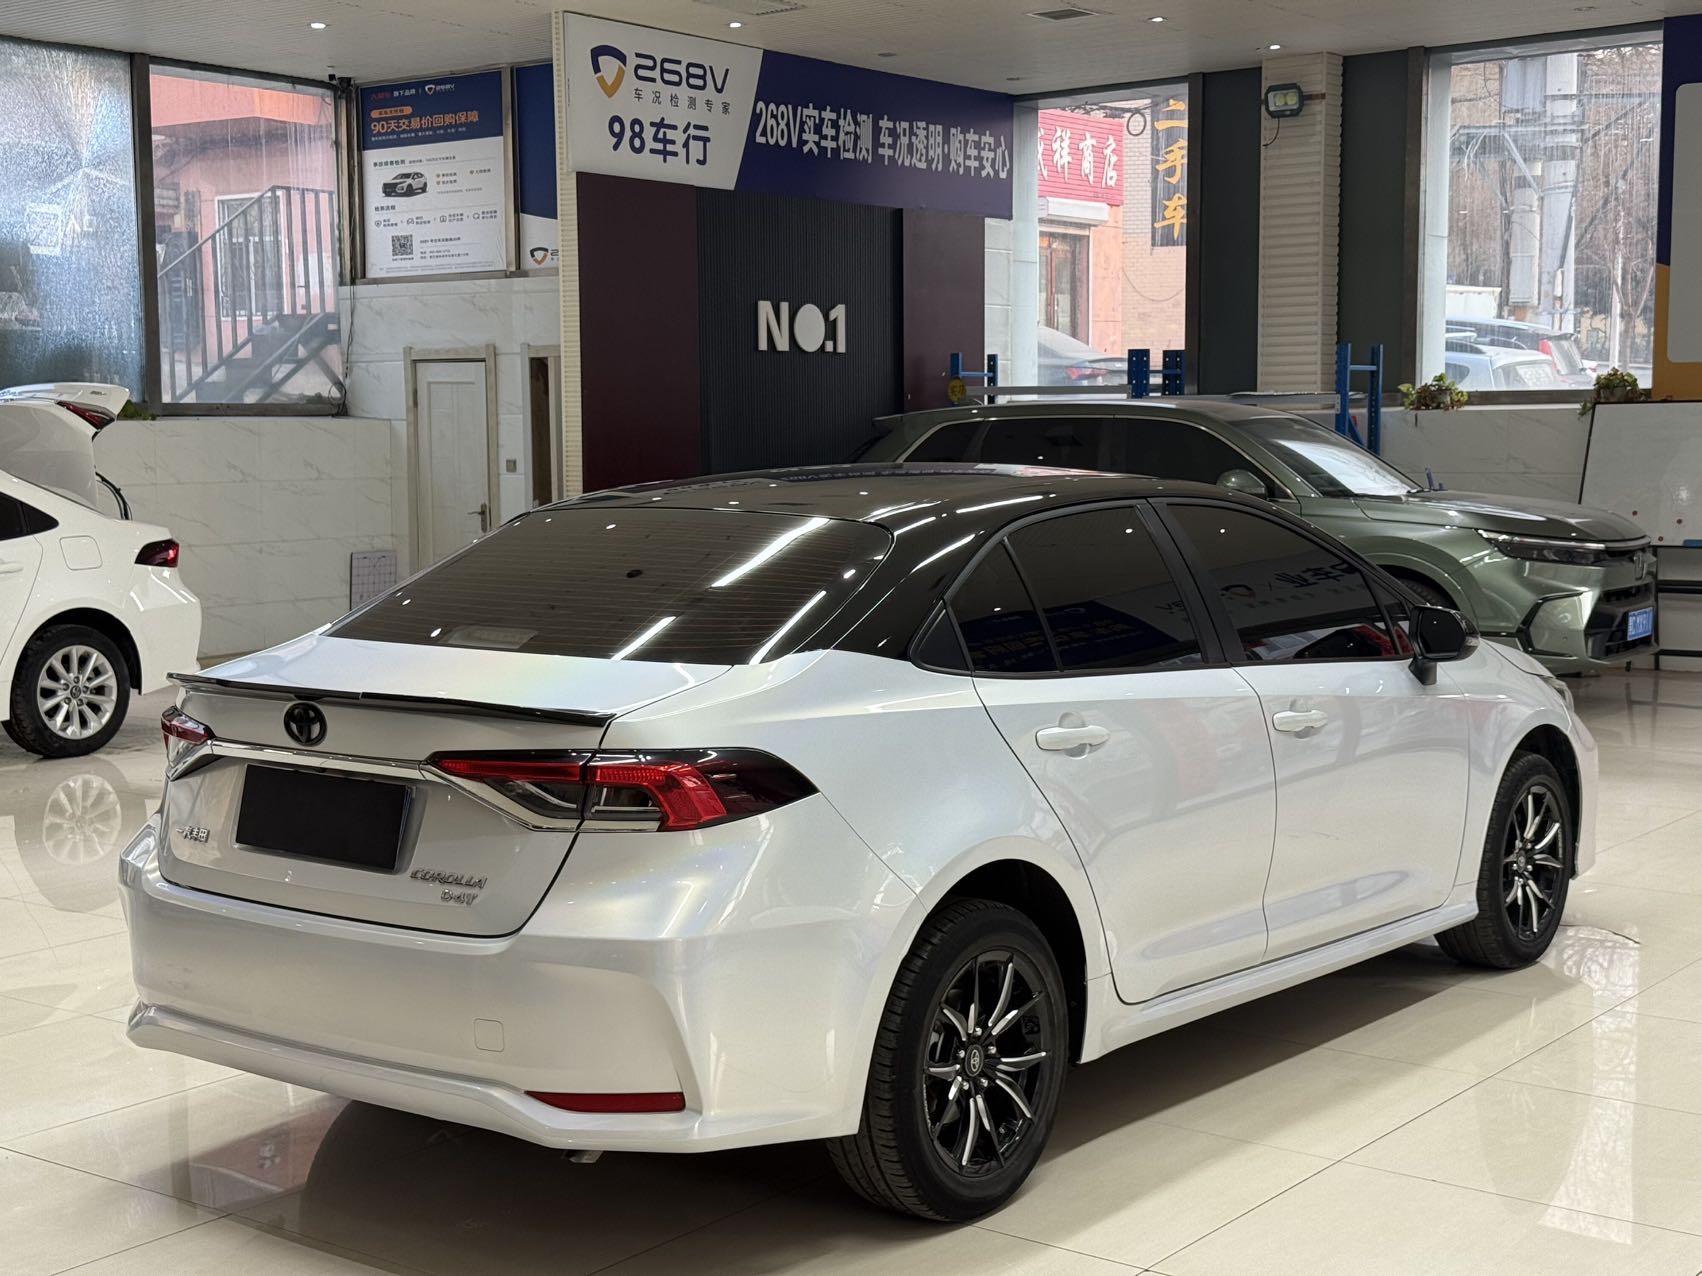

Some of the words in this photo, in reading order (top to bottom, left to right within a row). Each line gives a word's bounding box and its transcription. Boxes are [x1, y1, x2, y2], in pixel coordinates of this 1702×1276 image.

[633, 52, 730, 94] 268V
[371, 110, 479, 134] 90天交易价回购保障
[633, 87, 731, 116] 车况检测专家
[608, 114, 711, 166] 98车行
[755, 100, 873, 164] 268V实车检测
[878, 114, 1010, 180] 车况透明·购车安心
[1153, 98, 1188, 241] 二手车
[757, 300, 846, 353] NO.1
[409, 868, 488, 889] COROLLA
